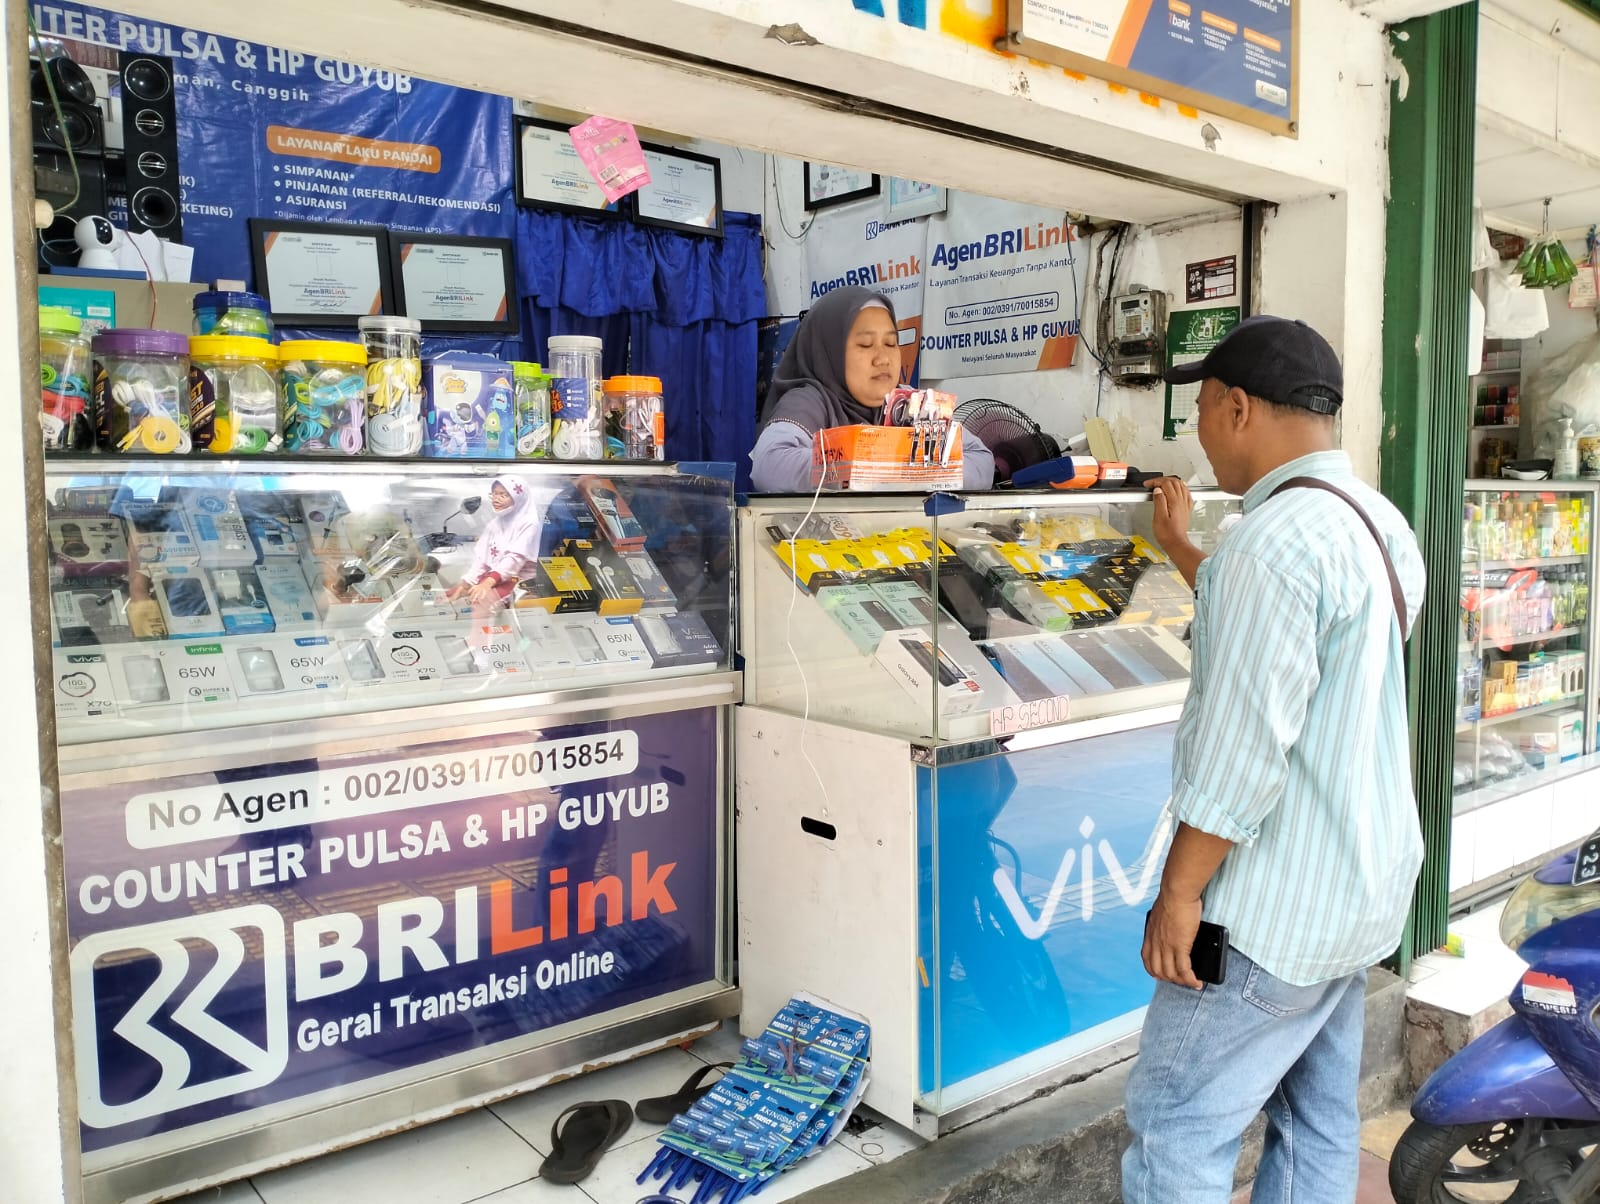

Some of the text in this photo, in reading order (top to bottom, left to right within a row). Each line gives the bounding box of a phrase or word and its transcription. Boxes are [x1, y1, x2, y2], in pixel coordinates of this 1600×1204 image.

[118, 19, 225, 64] PULSA
[234, 40, 257, 70] &
[267, 45, 305, 76] HP
[314, 55, 412, 94] GUYUB
[231, 78, 310, 102] Canggih
[277, 135, 433, 166] LAYANAN LAKU PANDAI
[285, 180, 501, 214] PINJAMAN (REFERRAL/REKOMENDASI)
[286, 196, 347, 211] ASURANSI
[180, 203, 233, 219] KETING)
[931, 217, 1078, 271] AgenBRILink
[810, 255, 921, 300] AgenBRILink
[929, 256, 1077, 289] Layanan Transaksi Keuangan Tanpa Kantor
[303, 287, 347, 296] AgenBRILink
[435, 294, 474, 303] AgenBRILink
[948, 310, 961, 320] No.
[982, 297, 1055, 317] 002/0391/70015854
[919, 332, 972, 351] COUNTER
[974, 326, 1008, 346] PULSA
[1011, 326, 1019, 342] &
[1022, 323, 1038, 341] HP
[481, 643, 512, 655] 65W
[607, 633, 633, 643] 65W
[178, 665, 216, 679] 65W
[290, 655, 325, 669] 65W
[1017, 695, 1069, 729] SECOND
[147, 799, 201, 832] No
[213, 787, 311, 831] Agen
[343, 738, 625, 804] 002/0391/70015854
[78, 781, 671, 915] COUNTER PULSA & HP GUYUB
[293, 850, 679, 1003] BRILink
[297, 950, 615, 1054] Gerai Transaksi Online
[720, 1088, 755, 1107] KINGSMAN
[764, 1107, 801, 1129] KINGSMAN
